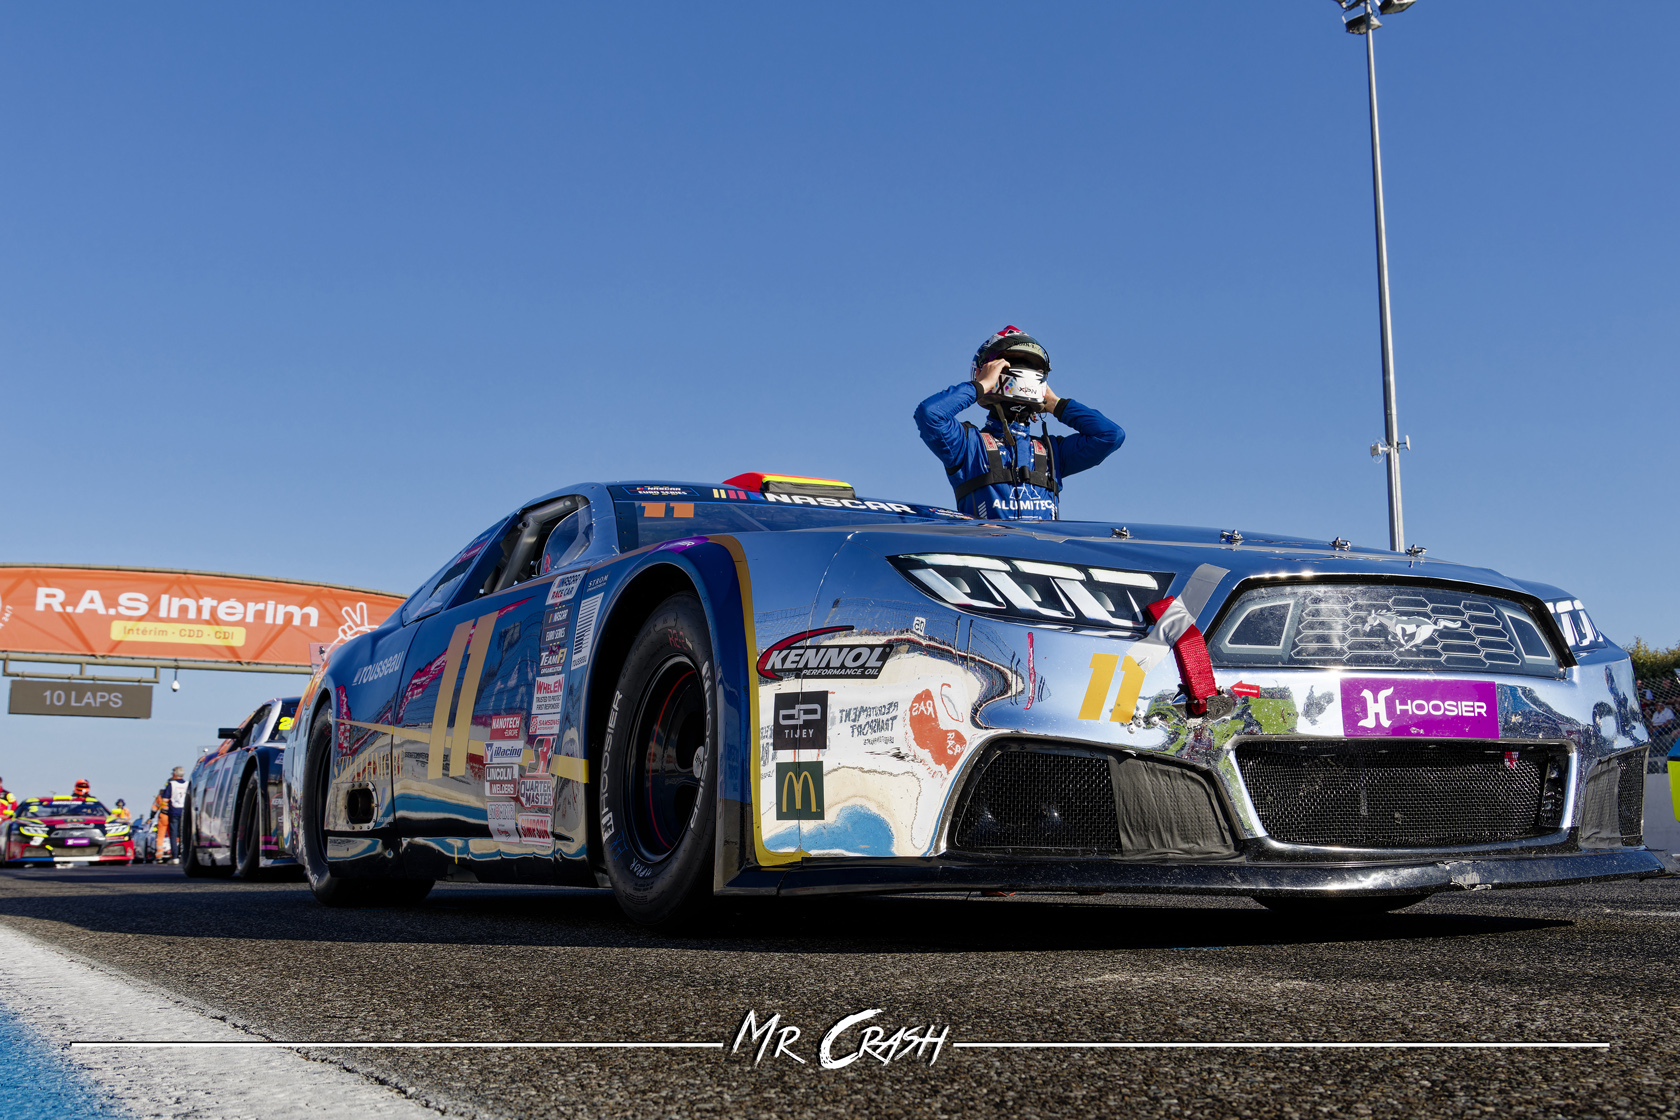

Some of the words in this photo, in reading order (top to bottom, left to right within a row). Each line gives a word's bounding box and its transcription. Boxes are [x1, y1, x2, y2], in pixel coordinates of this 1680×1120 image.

[641, 502, 695, 518] 11
[763, 492, 917, 515] NASCAR
[551, 589, 563, 600] RACE
[563, 586, 574, 597] CAR
[35, 587, 149, 617] R.A.S
[158, 593, 319, 628] Intérim
[123, 625, 168, 637] Intérim
[179, 628, 204, 638] CDD
[214, 630, 234, 640] CDI
[764, 647, 884, 670] KENNOL
[801, 668, 863, 676] PERFORMANCE
[536, 676, 564, 695] WHELEN
[1077, 652, 1146, 723] 11
[42, 690, 66, 706] 10
[70, 691, 123, 708] LAPS
[428, 610, 500, 780] 11
[1396, 699, 1488, 717] HOOSIER
[491, 716, 521, 730] NANOTECH
[784, 729, 814, 738] TIJEY
[493, 745, 523, 758] iRacing
[601, 690, 623, 810] HOOSIER
[486, 767, 513, 780] LINCOLN
[491, 783, 515, 794] WELDERS
[520, 780, 551, 799] QUARTER
[525, 792, 552, 806] MASTER
